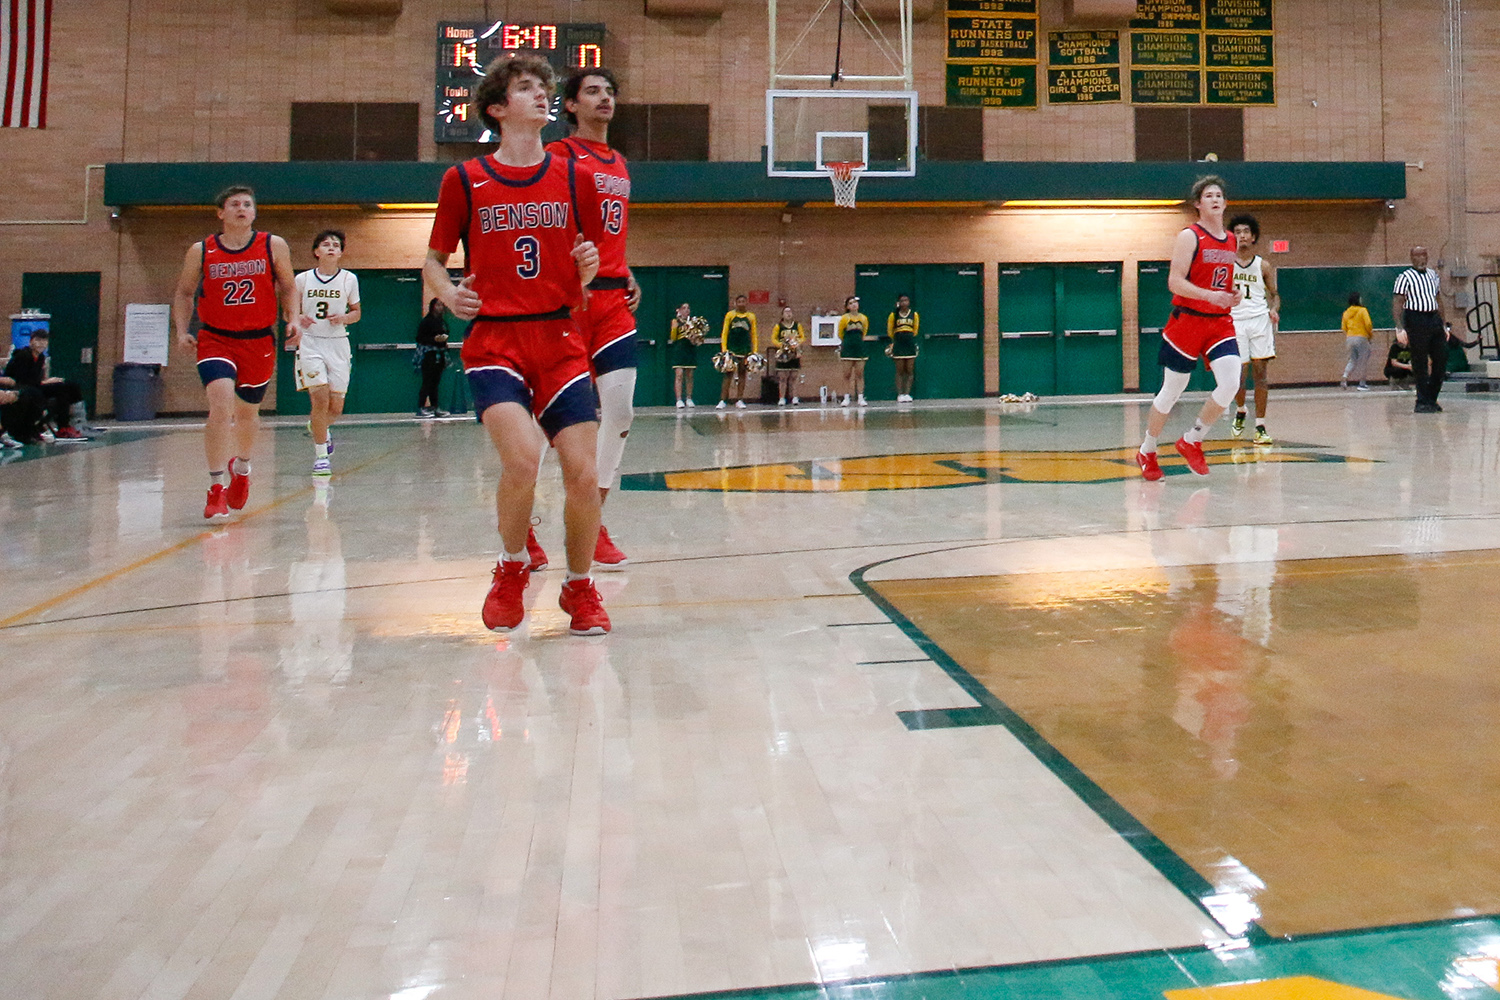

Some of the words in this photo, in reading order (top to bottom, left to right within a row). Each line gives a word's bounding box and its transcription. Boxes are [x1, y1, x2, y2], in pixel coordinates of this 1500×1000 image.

[1211, 8, 1266, 16] CHAMPIONS
[972, 20, 1012, 29] STATE
[445, 27, 475, 38] Home
[503, 25, 557, 49] 6:47
[951, 29, 1012, 39] RUNNERS
[1016, 30, 1034, 40] UP
[1143, 34, 1187, 42] DIVISION
[1218, 36, 1260, 44] DIVISION
[956, 40, 976, 48] BOYS
[980, 40, 1028, 49] BASKETBALL
[1057, 40, 1110, 48] CHAMPIONS
[1137, 42, 1193, 51] CHAMPIONS
[1212, 44, 1267, 53] CHAMPIONS
[1060, 47, 1108, 56] SOFTBALL
[973, 66, 1011, 76] STATE
[1071, 69, 1108, 78] LEAGUE
[1144, 72, 1188, 80] DIVISION
[1219, 73, 1261, 81] DIVISION
[958, 77, 1025, 87] RUNNER-UP
[1057, 77, 1111, 86] CHAMPIONS
[1137, 80, 1194, 89] CHAMPIONS
[1212, 81, 1267, 89] CHAMPIONS
[960, 88, 987, 96] GIRLS
[990, 88, 1022, 96] TENNIS
[1082, 84, 1119, 93] SOCCER
[454, 104, 467, 121] 4
[594, 172, 631, 198] ENSON
[478, 202, 568, 234] BENSON
[601, 198, 624, 235] 13
[514, 235, 540, 279] 3
[209, 258, 266, 279] BENSON
[1211, 266, 1229, 289] 12
[1234, 273, 1257, 282] AGLES
[223, 279, 255, 306] 22
[307, 289, 341, 299] EAGLES
[316, 301, 329, 319] 3
